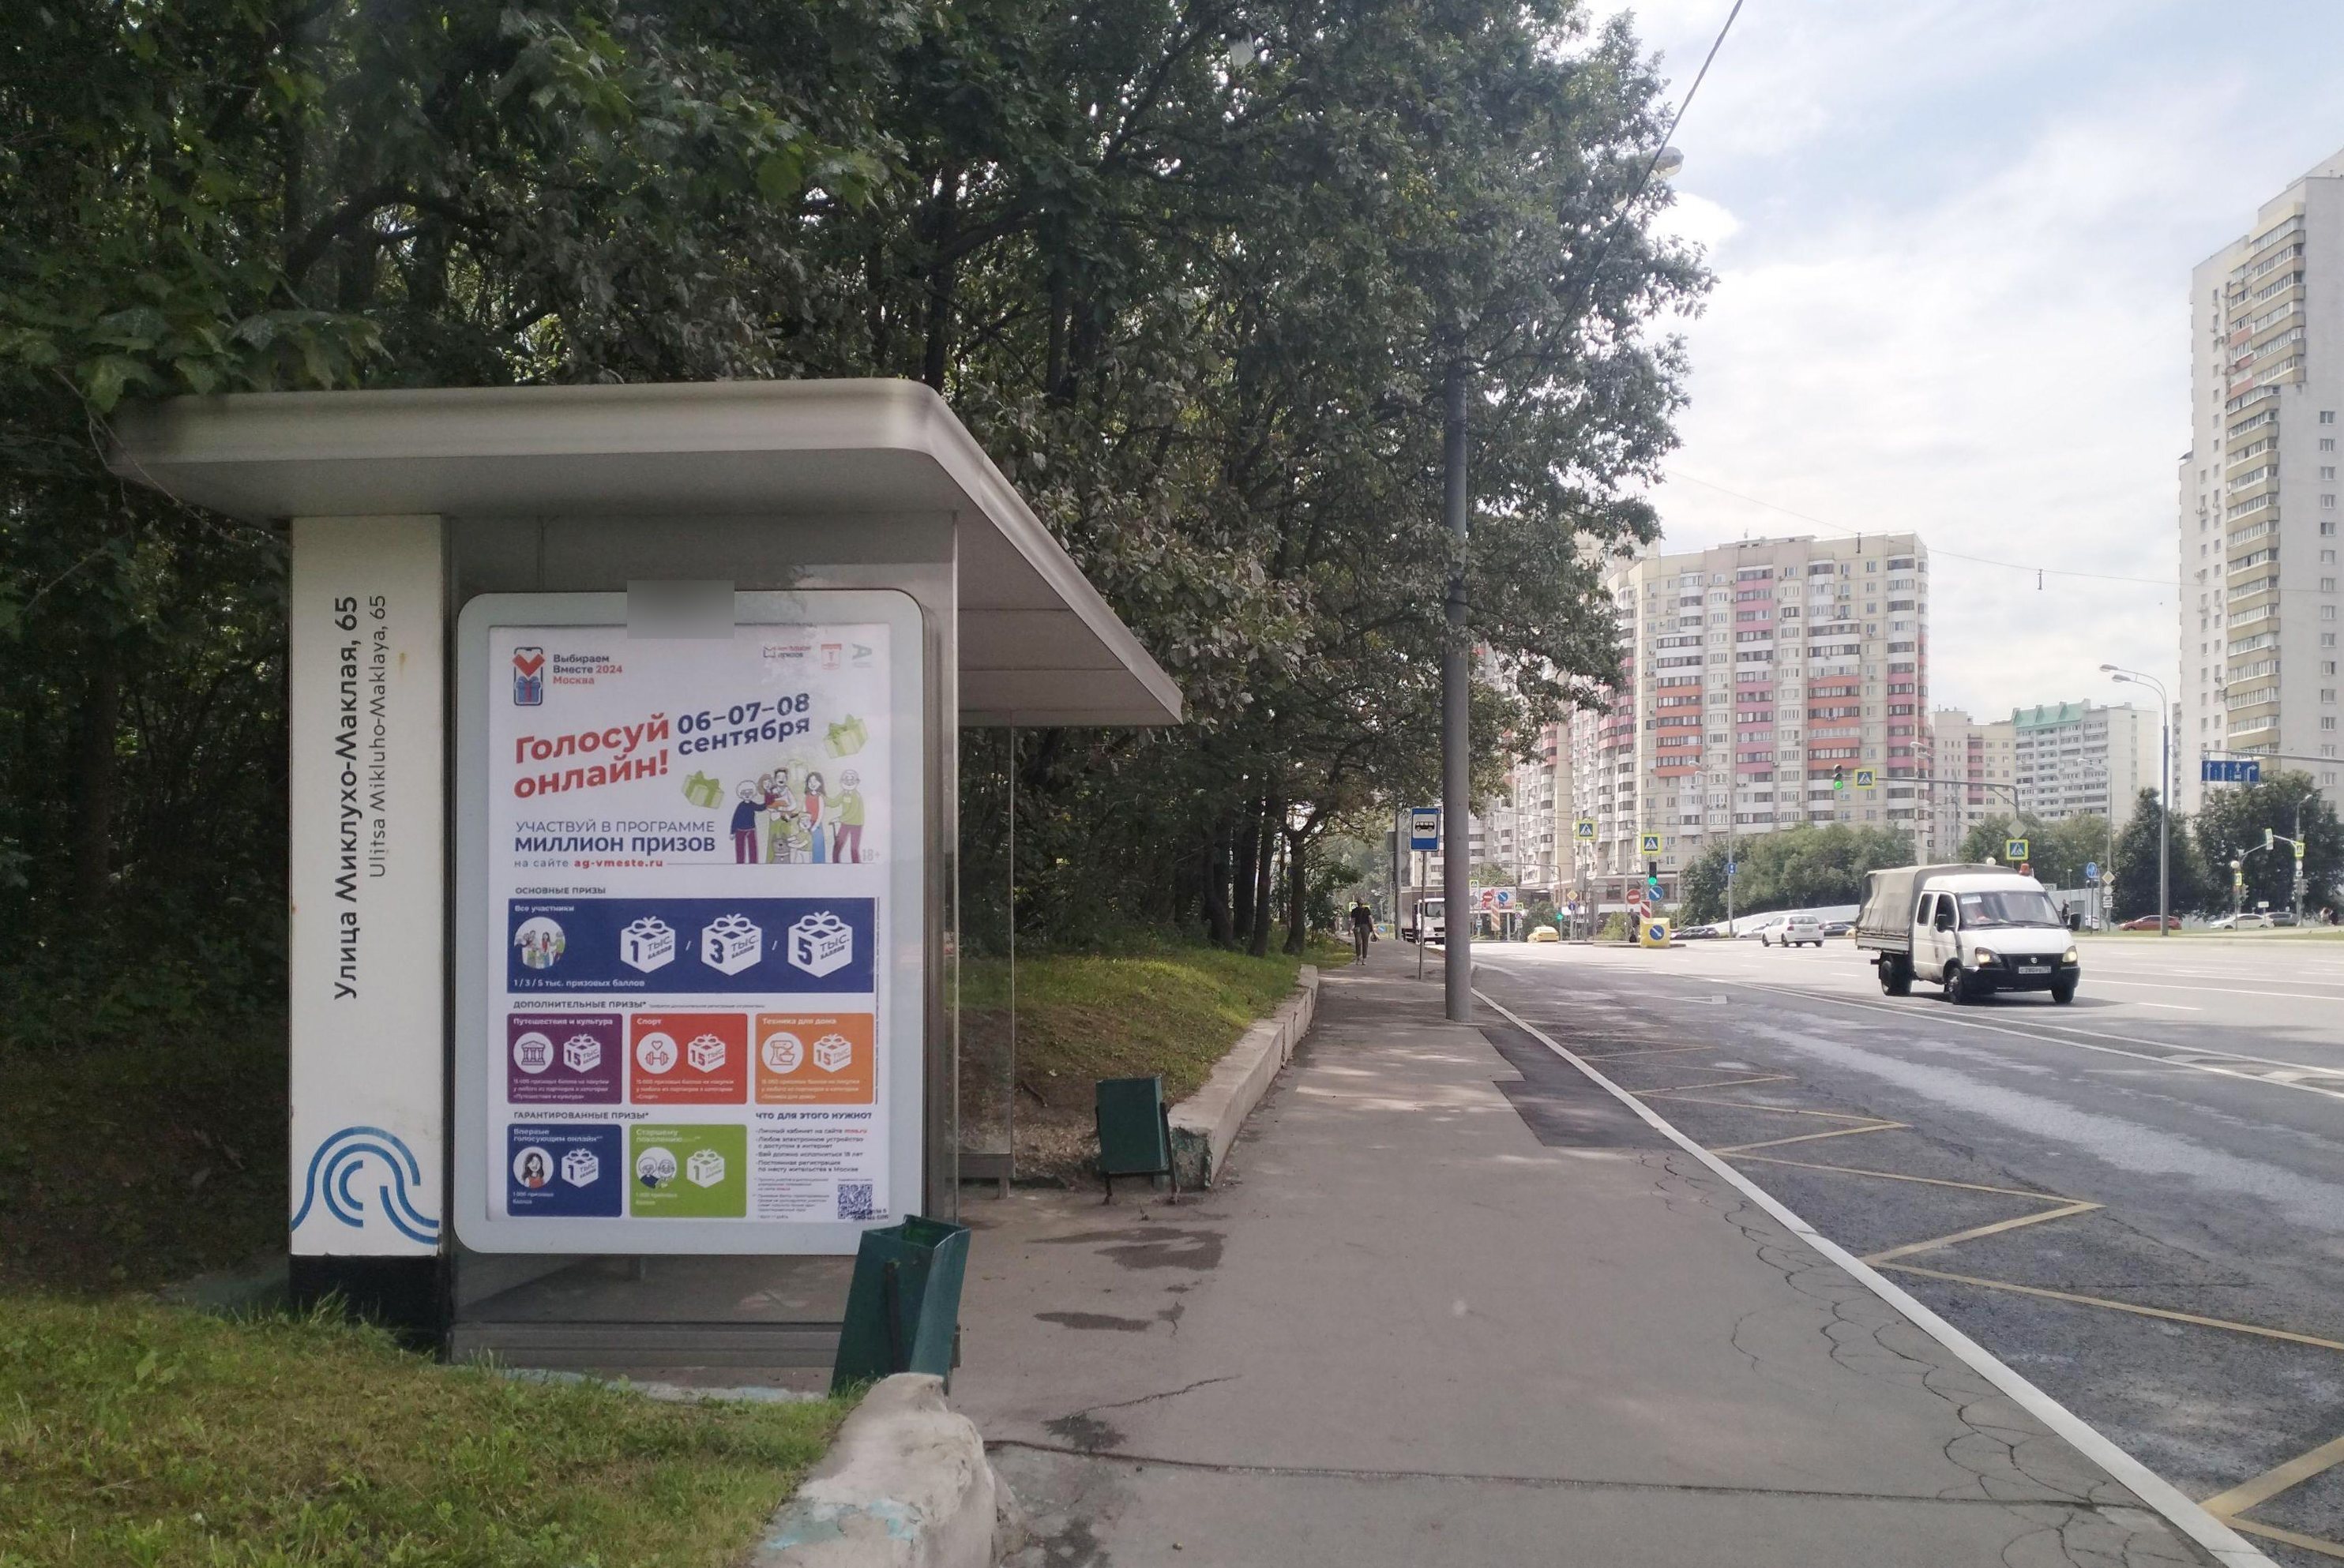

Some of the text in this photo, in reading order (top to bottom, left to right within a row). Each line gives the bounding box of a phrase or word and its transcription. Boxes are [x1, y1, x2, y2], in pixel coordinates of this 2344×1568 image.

[553, 654, 610, 664] Выбираем
[553, 665, 623, 673] Вместе 2024
[553, 676, 595, 685] Москва
[369, 595, 389, 878] Ulitsa Mikluho-Maklaya, 65
[516, 712, 670, 764] Голосуй
[677, 717, 810, 756] сентября
[513, 749, 669, 799] онлайн!
[333, 596, 362, 1000] Улица Миклухо-Маклая, 65
[516, 820, 716, 833] УЧАСТВУЙ В ПРОГРАММЕ
[515, 837, 716, 856] миллион призов
[533, 858, 569, 868] сайте
[573, 859, 663, 869] ag-vmeste.ru
[629, 940, 639, 964] 1
[710, 938, 724, 964] 3
[797, 936, 813, 966] 5
[513, 1000, 607, 1009] ДОПОЛНИТЕЛЬНЫЕ
[568, 1165, 574, 1180] 1
